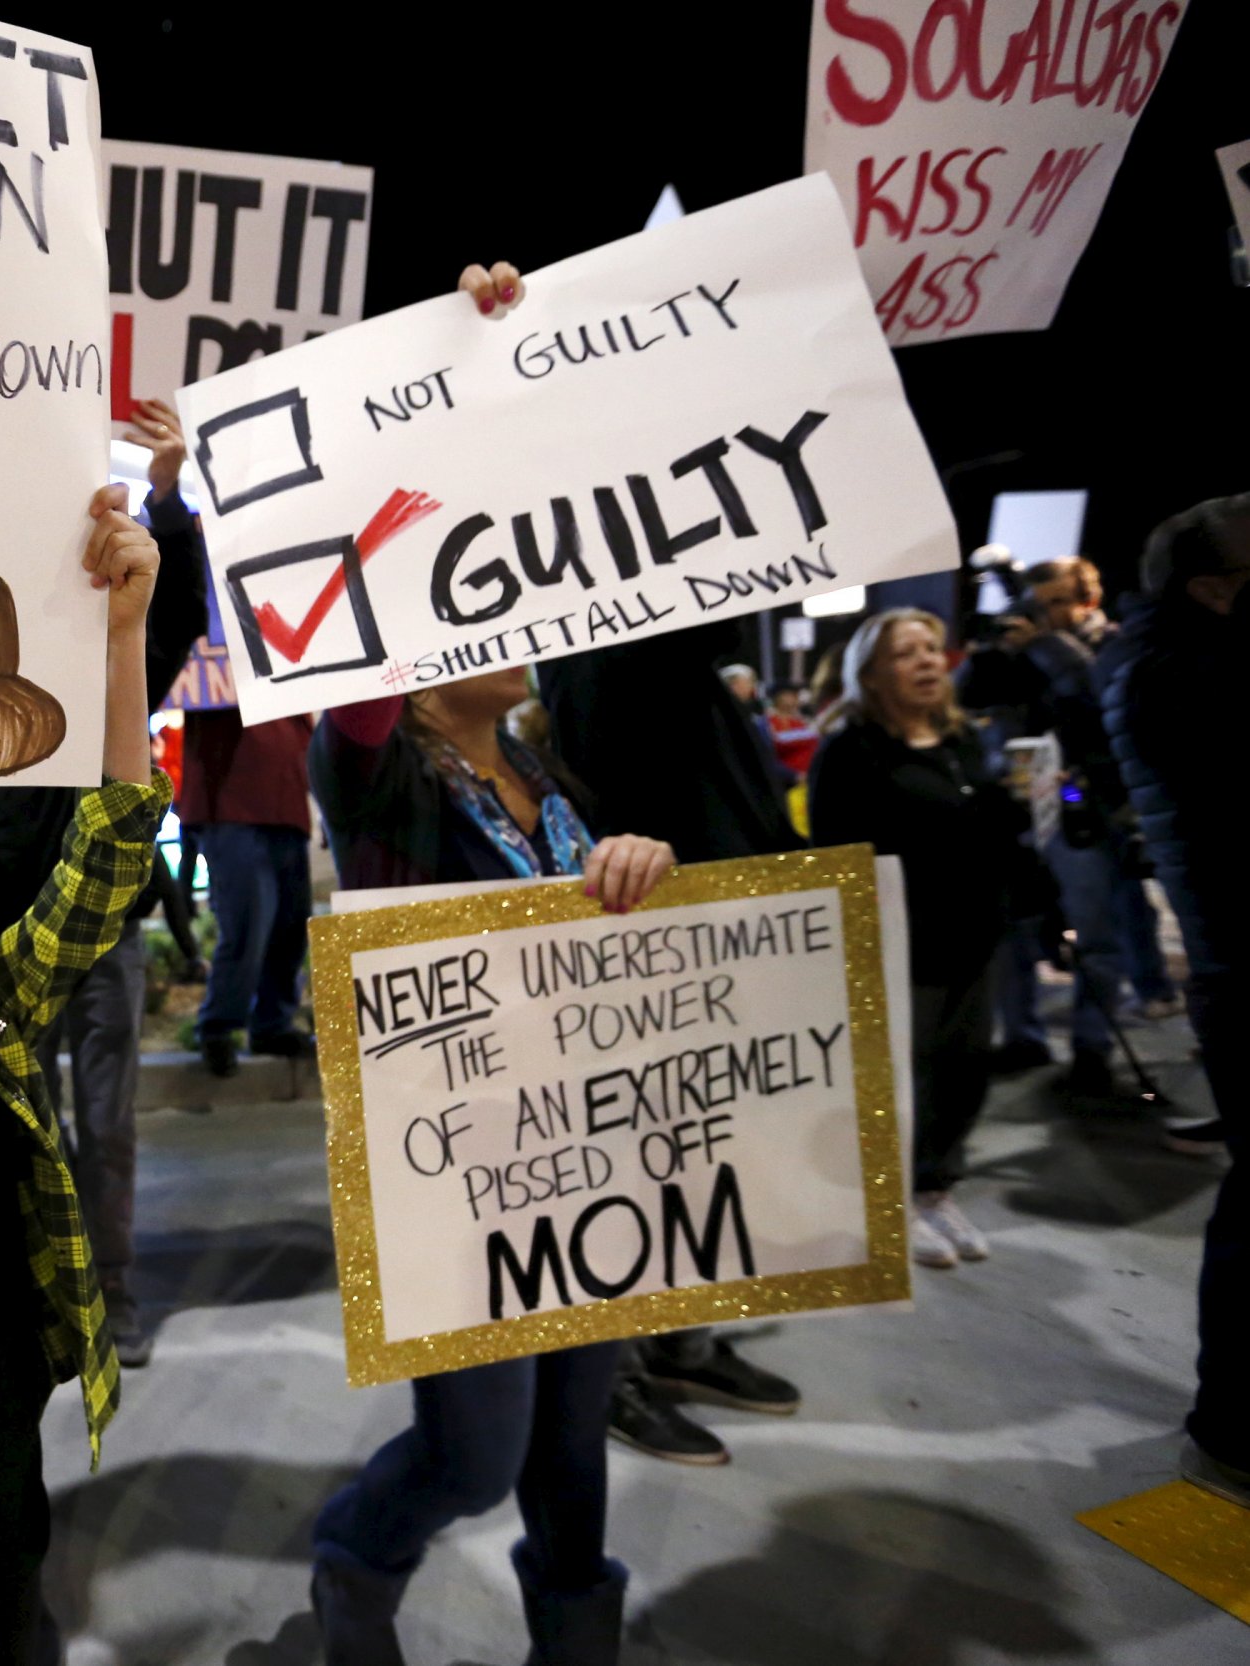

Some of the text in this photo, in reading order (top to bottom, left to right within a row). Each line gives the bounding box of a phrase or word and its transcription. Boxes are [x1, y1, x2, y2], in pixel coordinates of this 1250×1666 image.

[275, 182, 368, 317] IT
[853, 142, 1105, 249] KISS MY
[363, 278, 741, 432] NOT GUILTY
[430, 410, 830, 627] GUILTY
[683, 542, 838, 612] DOWN
[352, 906, 834, 1037] NEVER UNDERESTIMATE
[420, 973, 738, 1092] THE POWER
[403, 1022, 846, 1178] OF AN EXTREMELY
[462, 1113, 735, 1221] PISSED OFF
[486, 1161, 758, 1321] MOM
